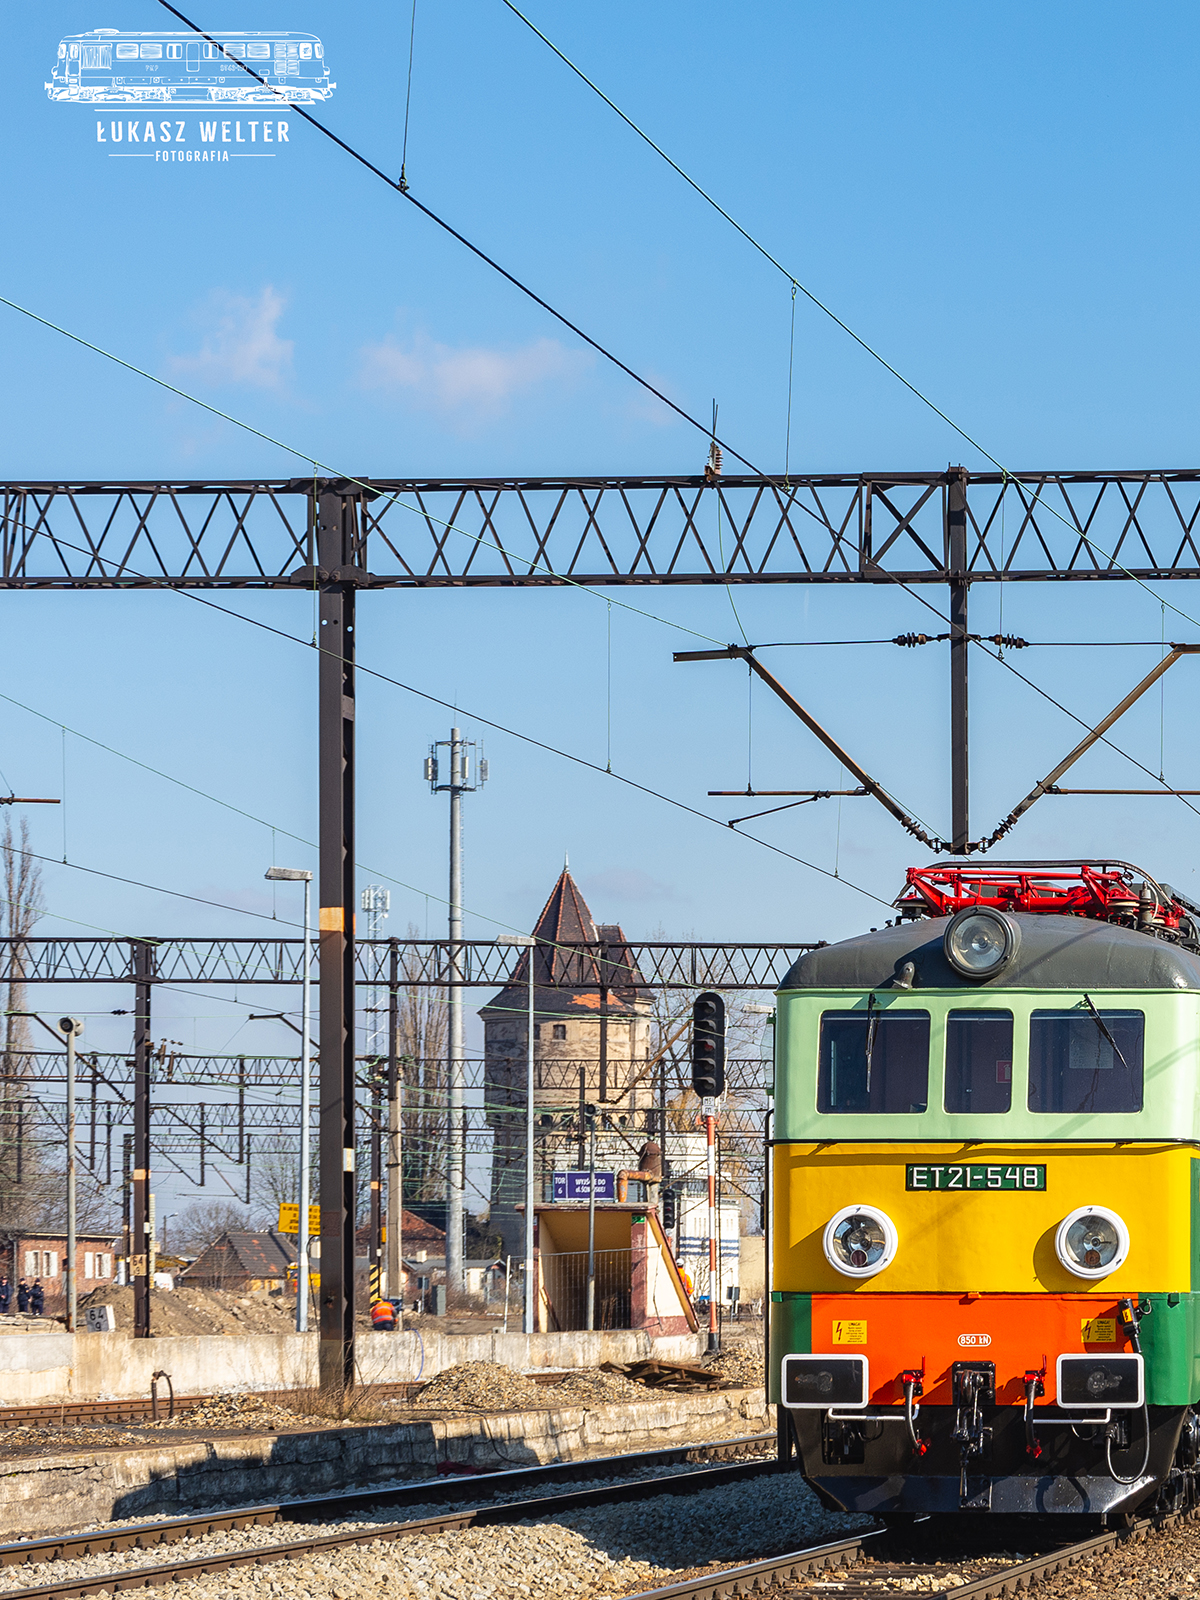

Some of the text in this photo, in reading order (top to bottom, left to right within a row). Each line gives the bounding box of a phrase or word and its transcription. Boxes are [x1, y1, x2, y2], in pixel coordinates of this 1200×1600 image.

[554, 1177, 566, 1185] TOR
[912, 1167, 1038, 1188] ET21-548
[89, 1309, 104, 1321] 64
[95, 1321, 102, 1332] 9
[960, 1335, 977, 1345] 850
